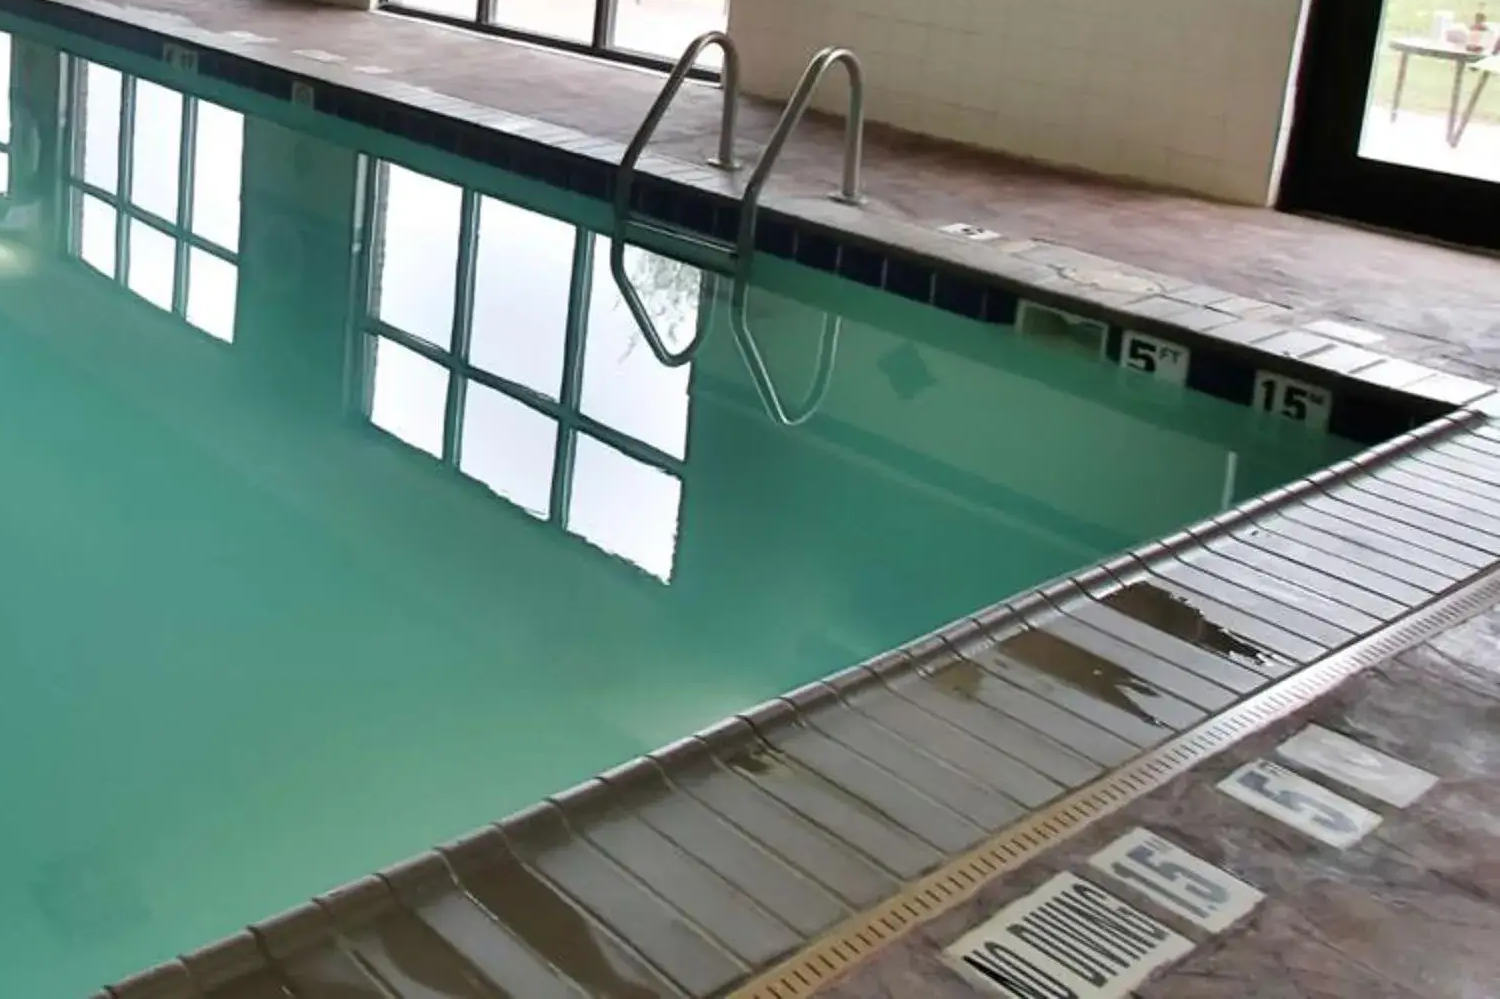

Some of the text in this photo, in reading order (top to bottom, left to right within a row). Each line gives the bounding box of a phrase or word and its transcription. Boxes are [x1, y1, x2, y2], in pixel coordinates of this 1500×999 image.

[1127, 338, 1179, 373] 5 FT
[1236, 770, 1360, 834] 5
[1005, 881, 1173, 990] DIVING
